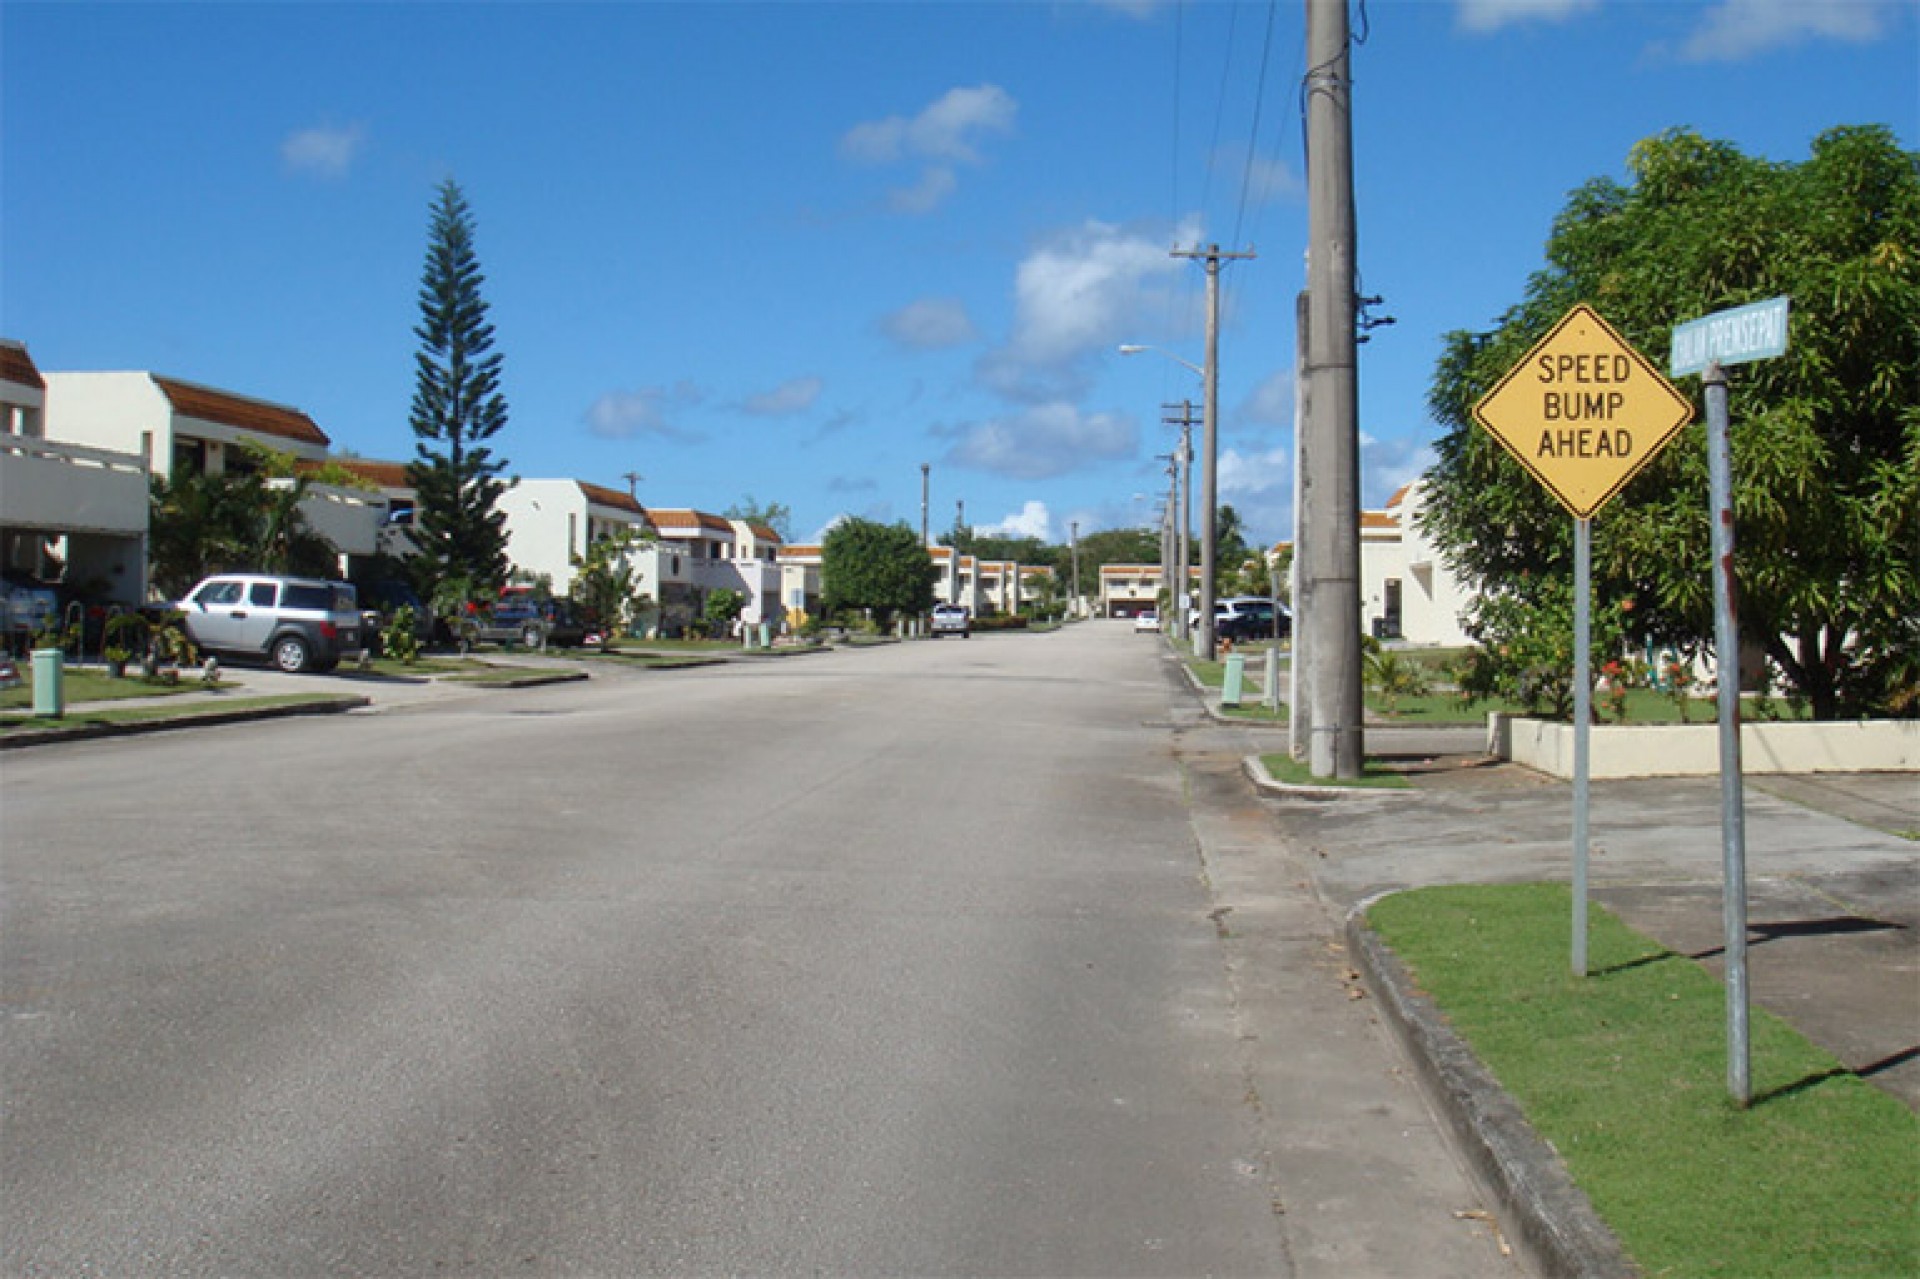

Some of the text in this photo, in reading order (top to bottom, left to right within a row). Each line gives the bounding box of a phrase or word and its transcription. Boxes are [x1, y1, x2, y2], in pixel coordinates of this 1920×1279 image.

[1537, 354, 1630, 383] SPEED
[1543, 392, 1623, 420] BUMP
[1537, 429, 1632, 458] AHEAD
